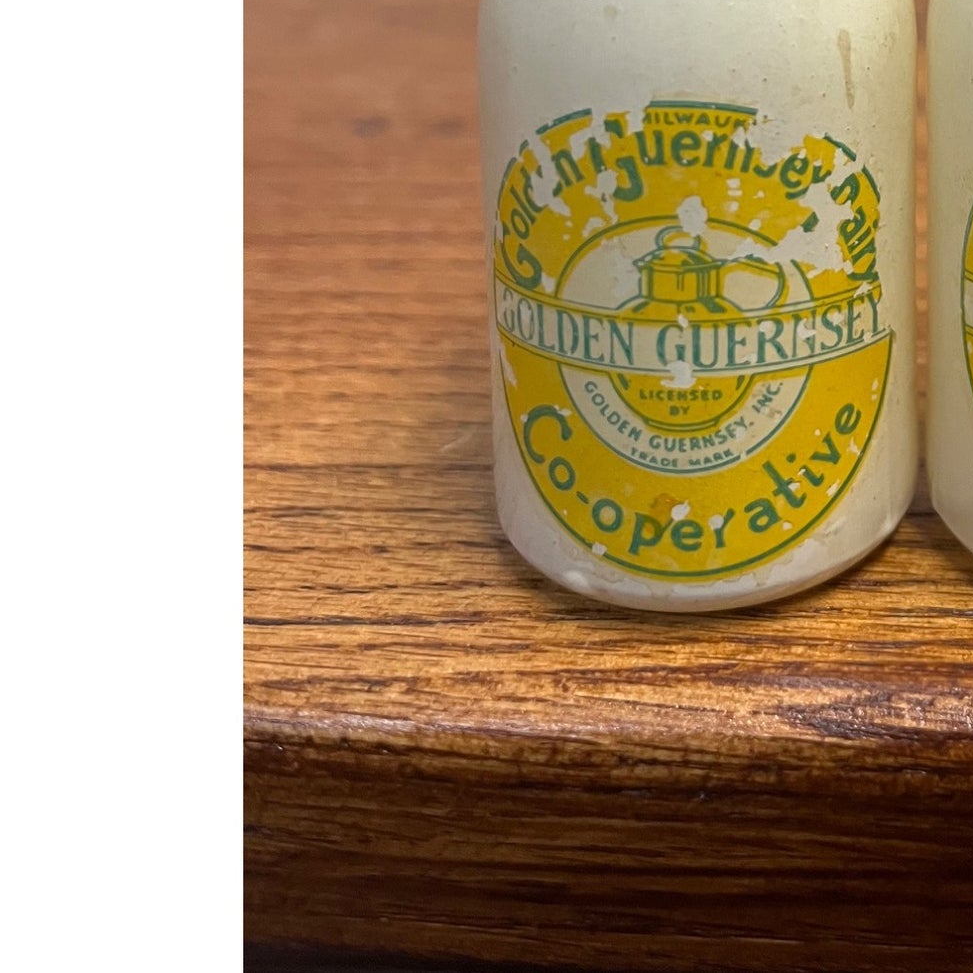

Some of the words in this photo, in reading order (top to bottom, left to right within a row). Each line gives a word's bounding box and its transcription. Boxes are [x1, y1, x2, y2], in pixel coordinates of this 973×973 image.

[502, 149, 585, 290] Goldn
[502, 287, 635, 366] GOLDEN
[656, 292, 886, 369] GUERNSEY
[584, 380, 643, 443] GOLDEN
[639, 388, 723, 402] LICENSED
[668, 404, 691, 416] BY
[523, 403, 862, 556] Co-operative
[630, 447, 679, 468] TRADE
[688, 447, 734, 468] MARK
